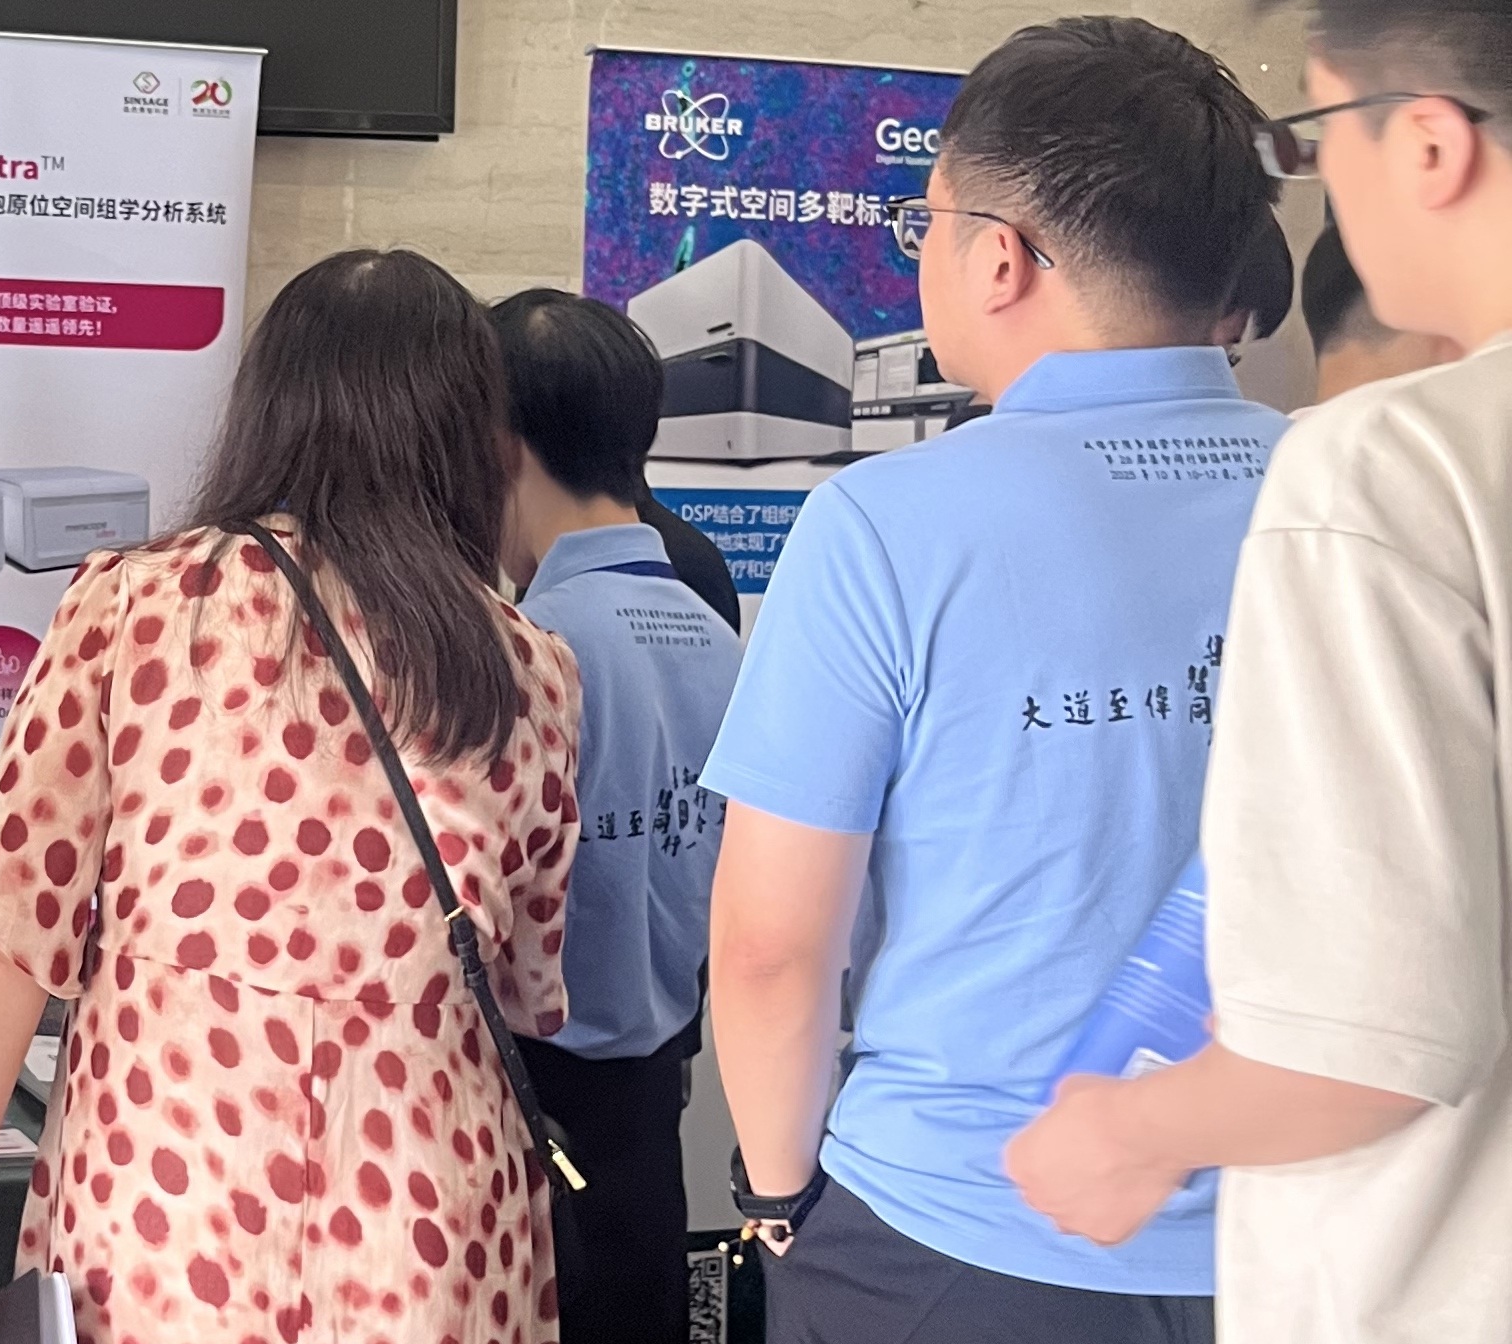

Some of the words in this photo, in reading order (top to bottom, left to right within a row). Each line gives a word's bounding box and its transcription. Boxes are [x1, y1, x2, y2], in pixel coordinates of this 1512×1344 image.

[123, 96, 169, 107] SINSAGE
[645, 114, 743, 136] BRUKER
[681, 503, 801, 525] DSP结合了组织
